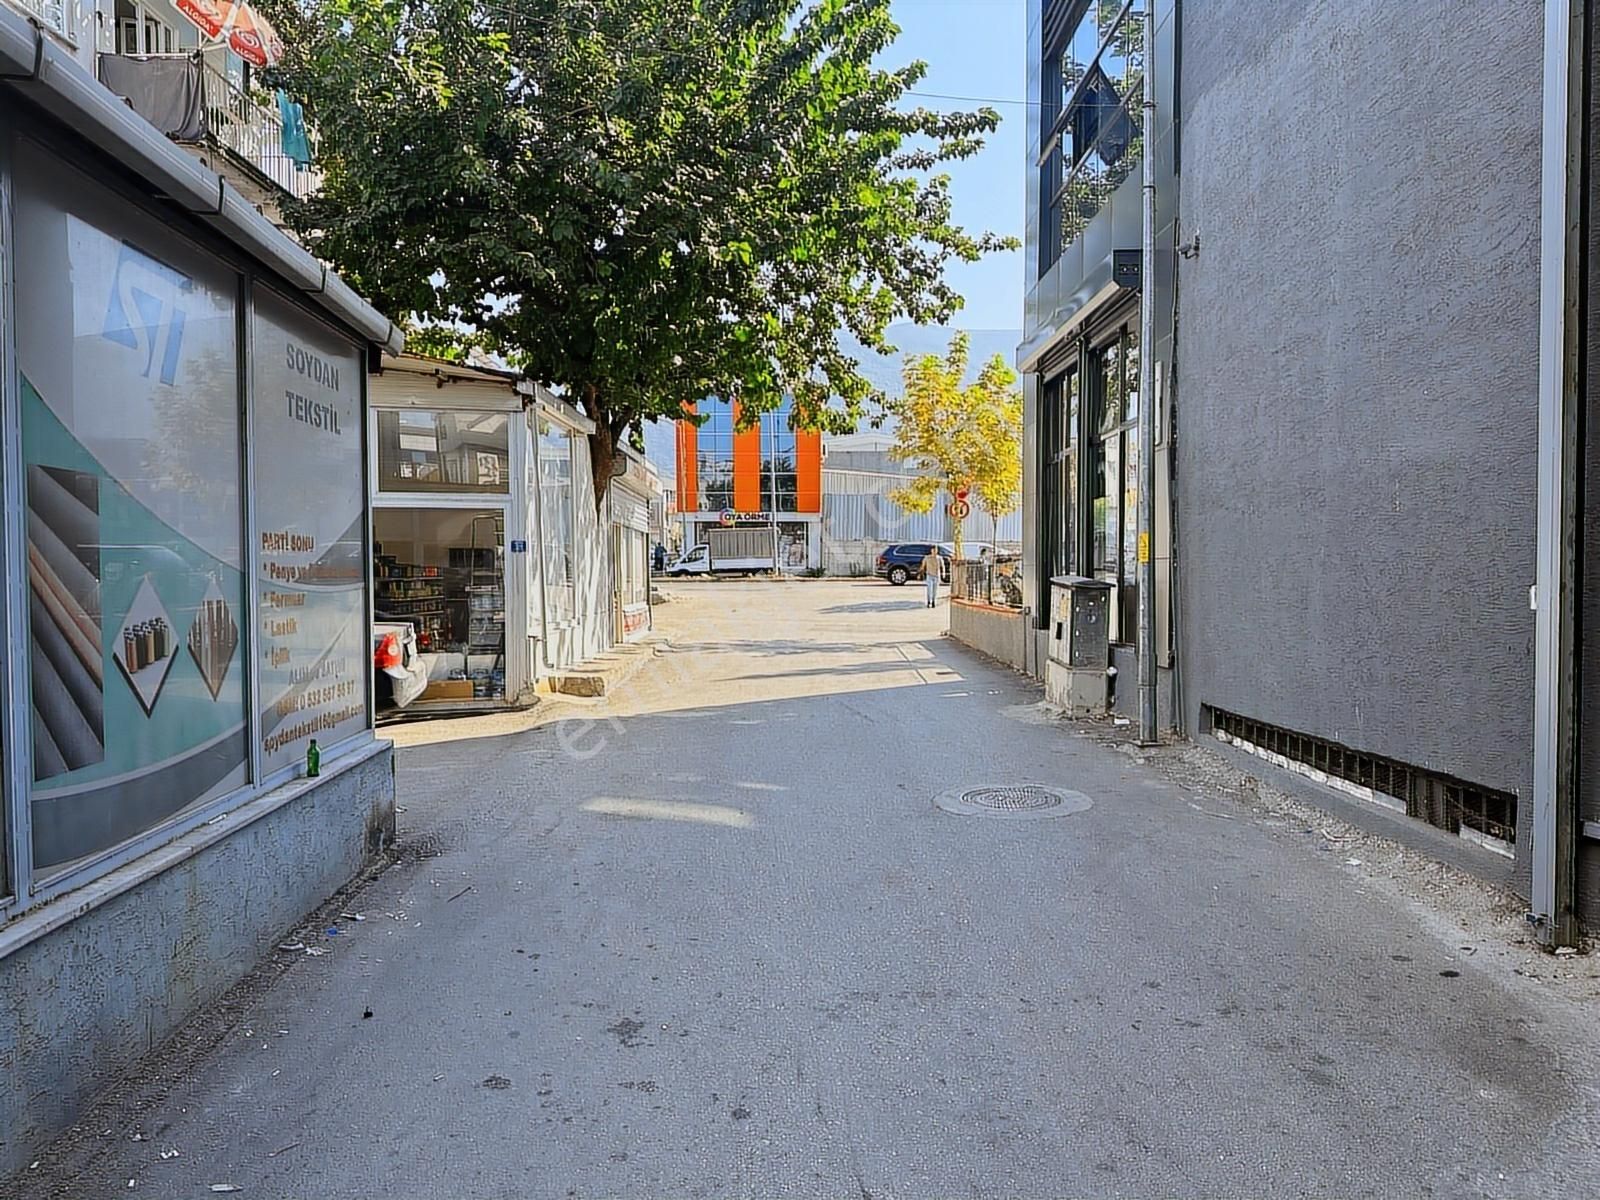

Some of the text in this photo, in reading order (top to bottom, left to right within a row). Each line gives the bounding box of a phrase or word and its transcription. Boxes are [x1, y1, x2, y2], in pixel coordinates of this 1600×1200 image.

[286, 343, 340, 392] SOYDAN
[285, 390, 341, 435] TEKSTİL
[291, 535, 314, 552] SONU
